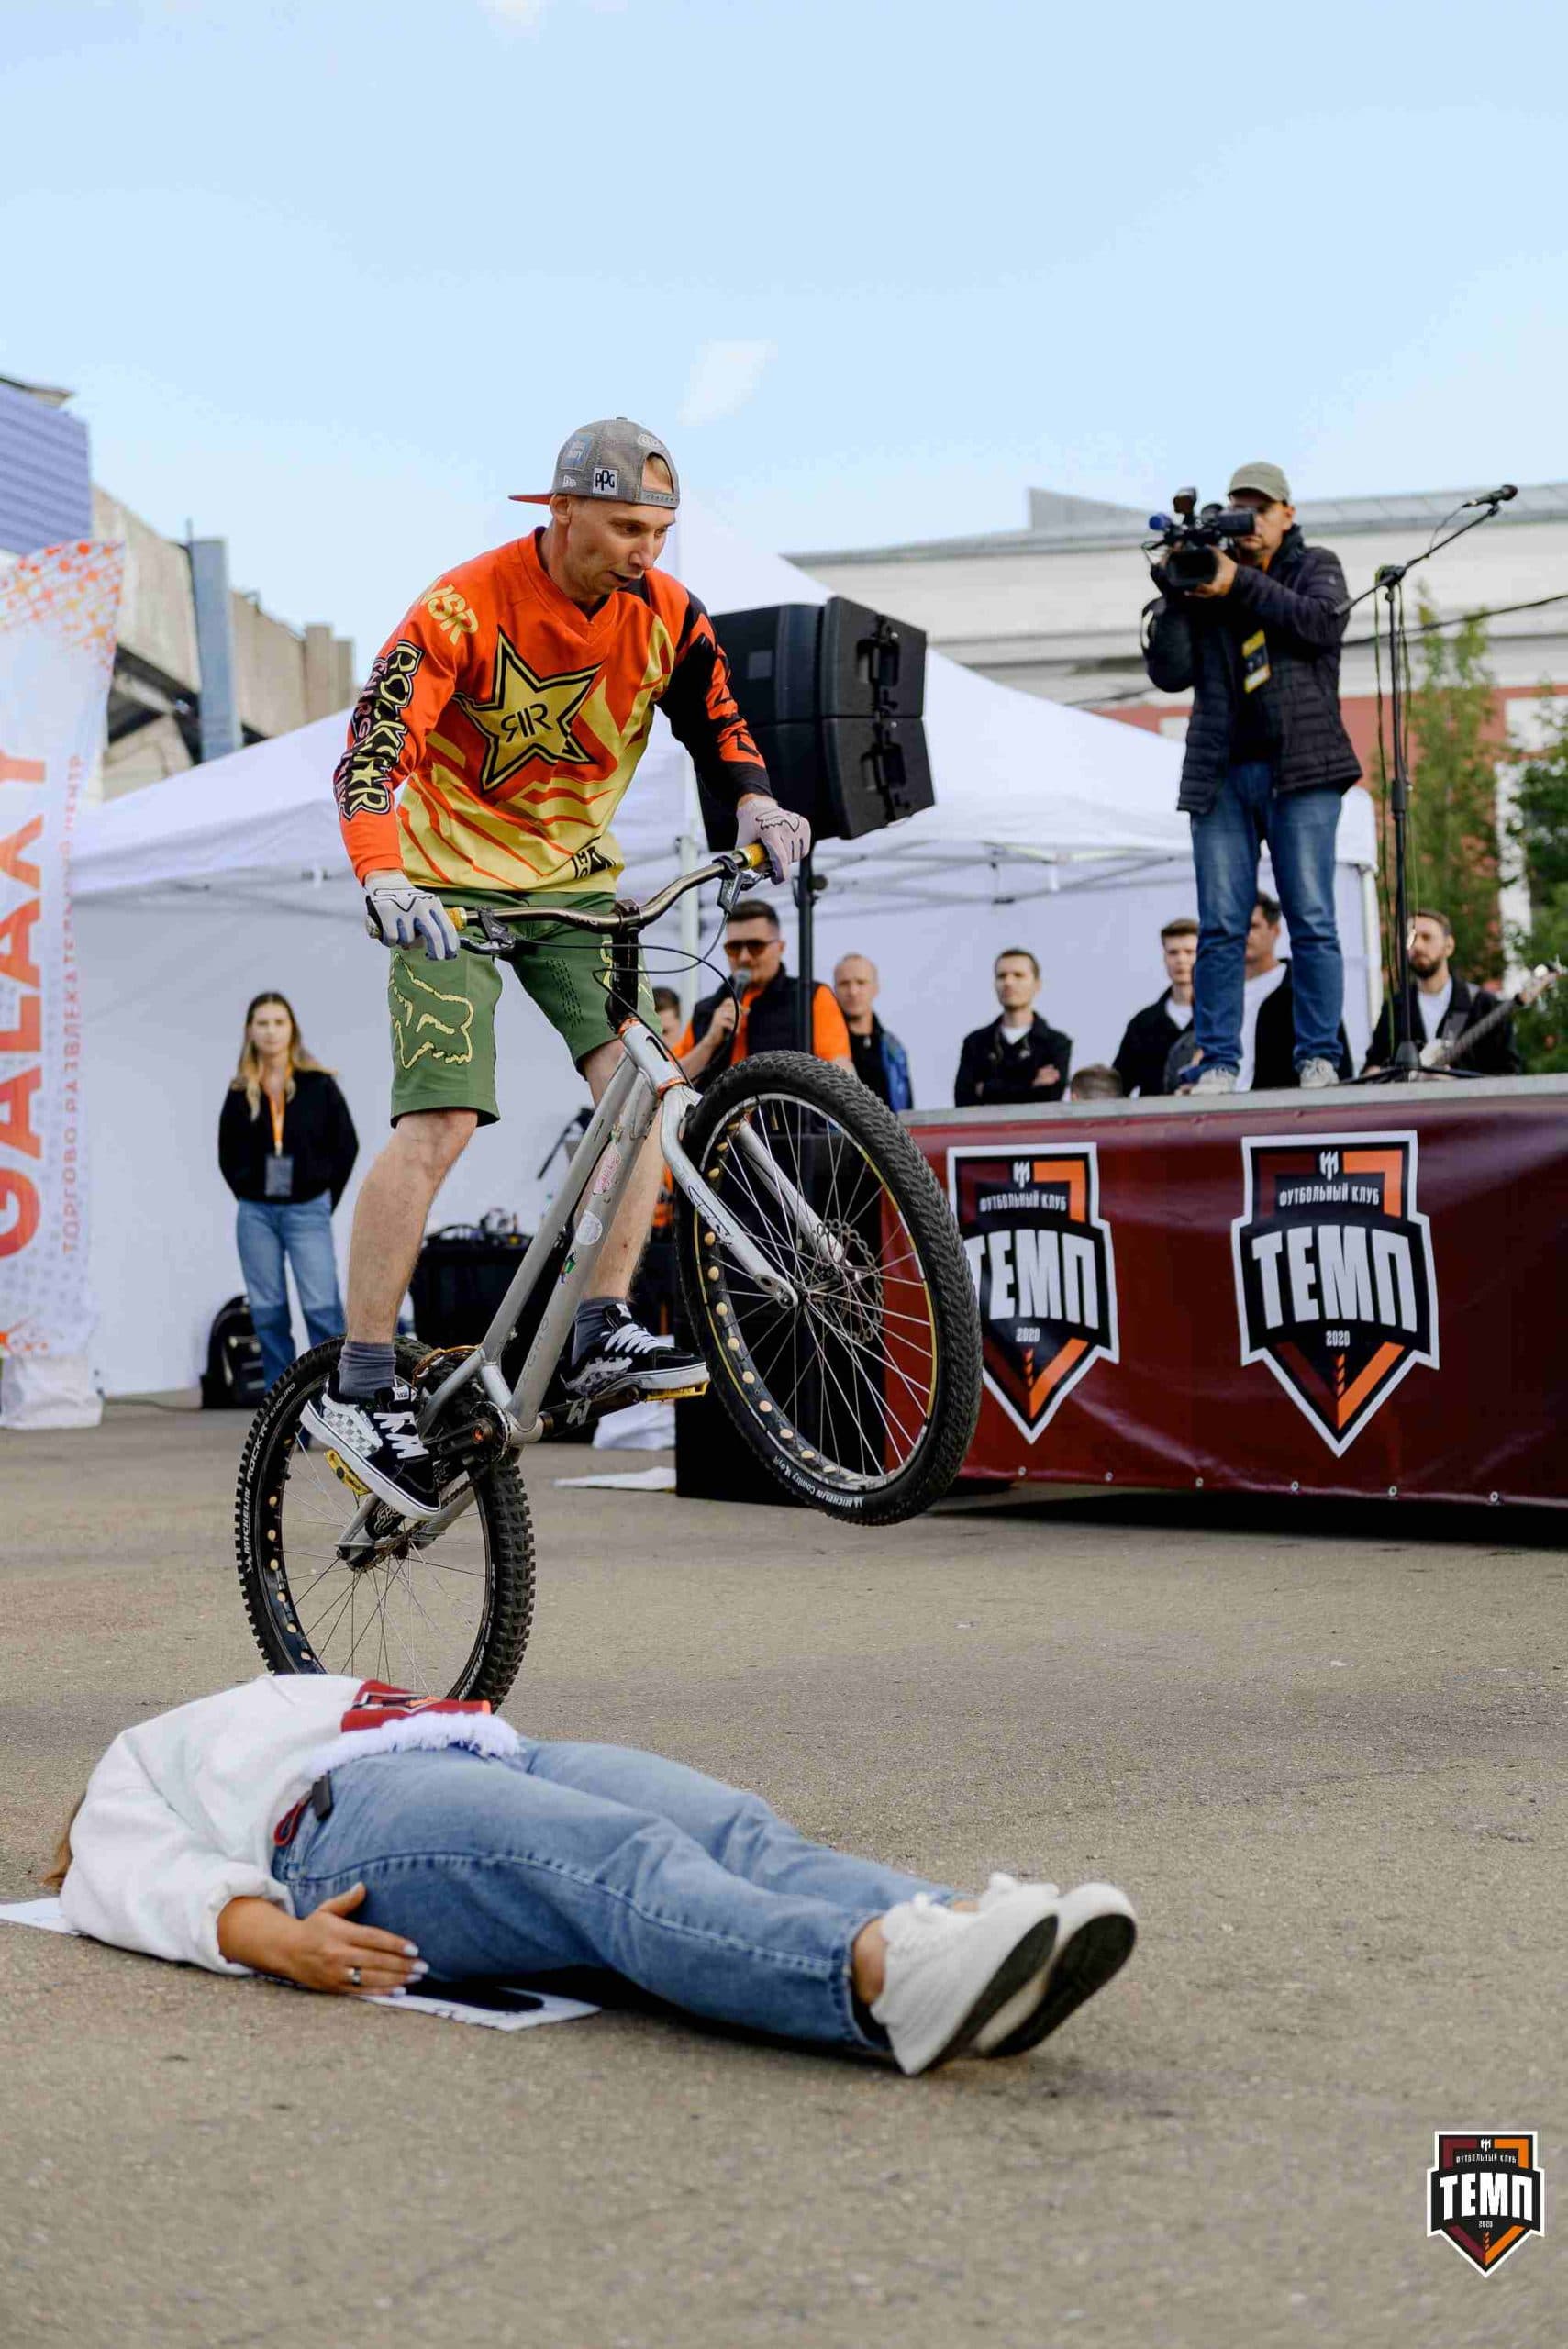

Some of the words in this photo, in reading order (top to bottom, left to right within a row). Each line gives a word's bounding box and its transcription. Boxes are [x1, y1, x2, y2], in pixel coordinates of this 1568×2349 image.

[979, 1190, 1040, 1212] ФУТБОЛЬНЫЙ
[1041, 1193, 1067, 1211] КЛУБ
[1279, 1182, 1348, 1207] ФУТБОЛЬНЫЙ
[1351, 1186, 1380, 1205] КЛУБ
[1251, 1225, 1418, 1333] ТЕМП
[1016, 1327, 1040, 1342] 2020
[1326, 1330, 1351, 1347] 2020
